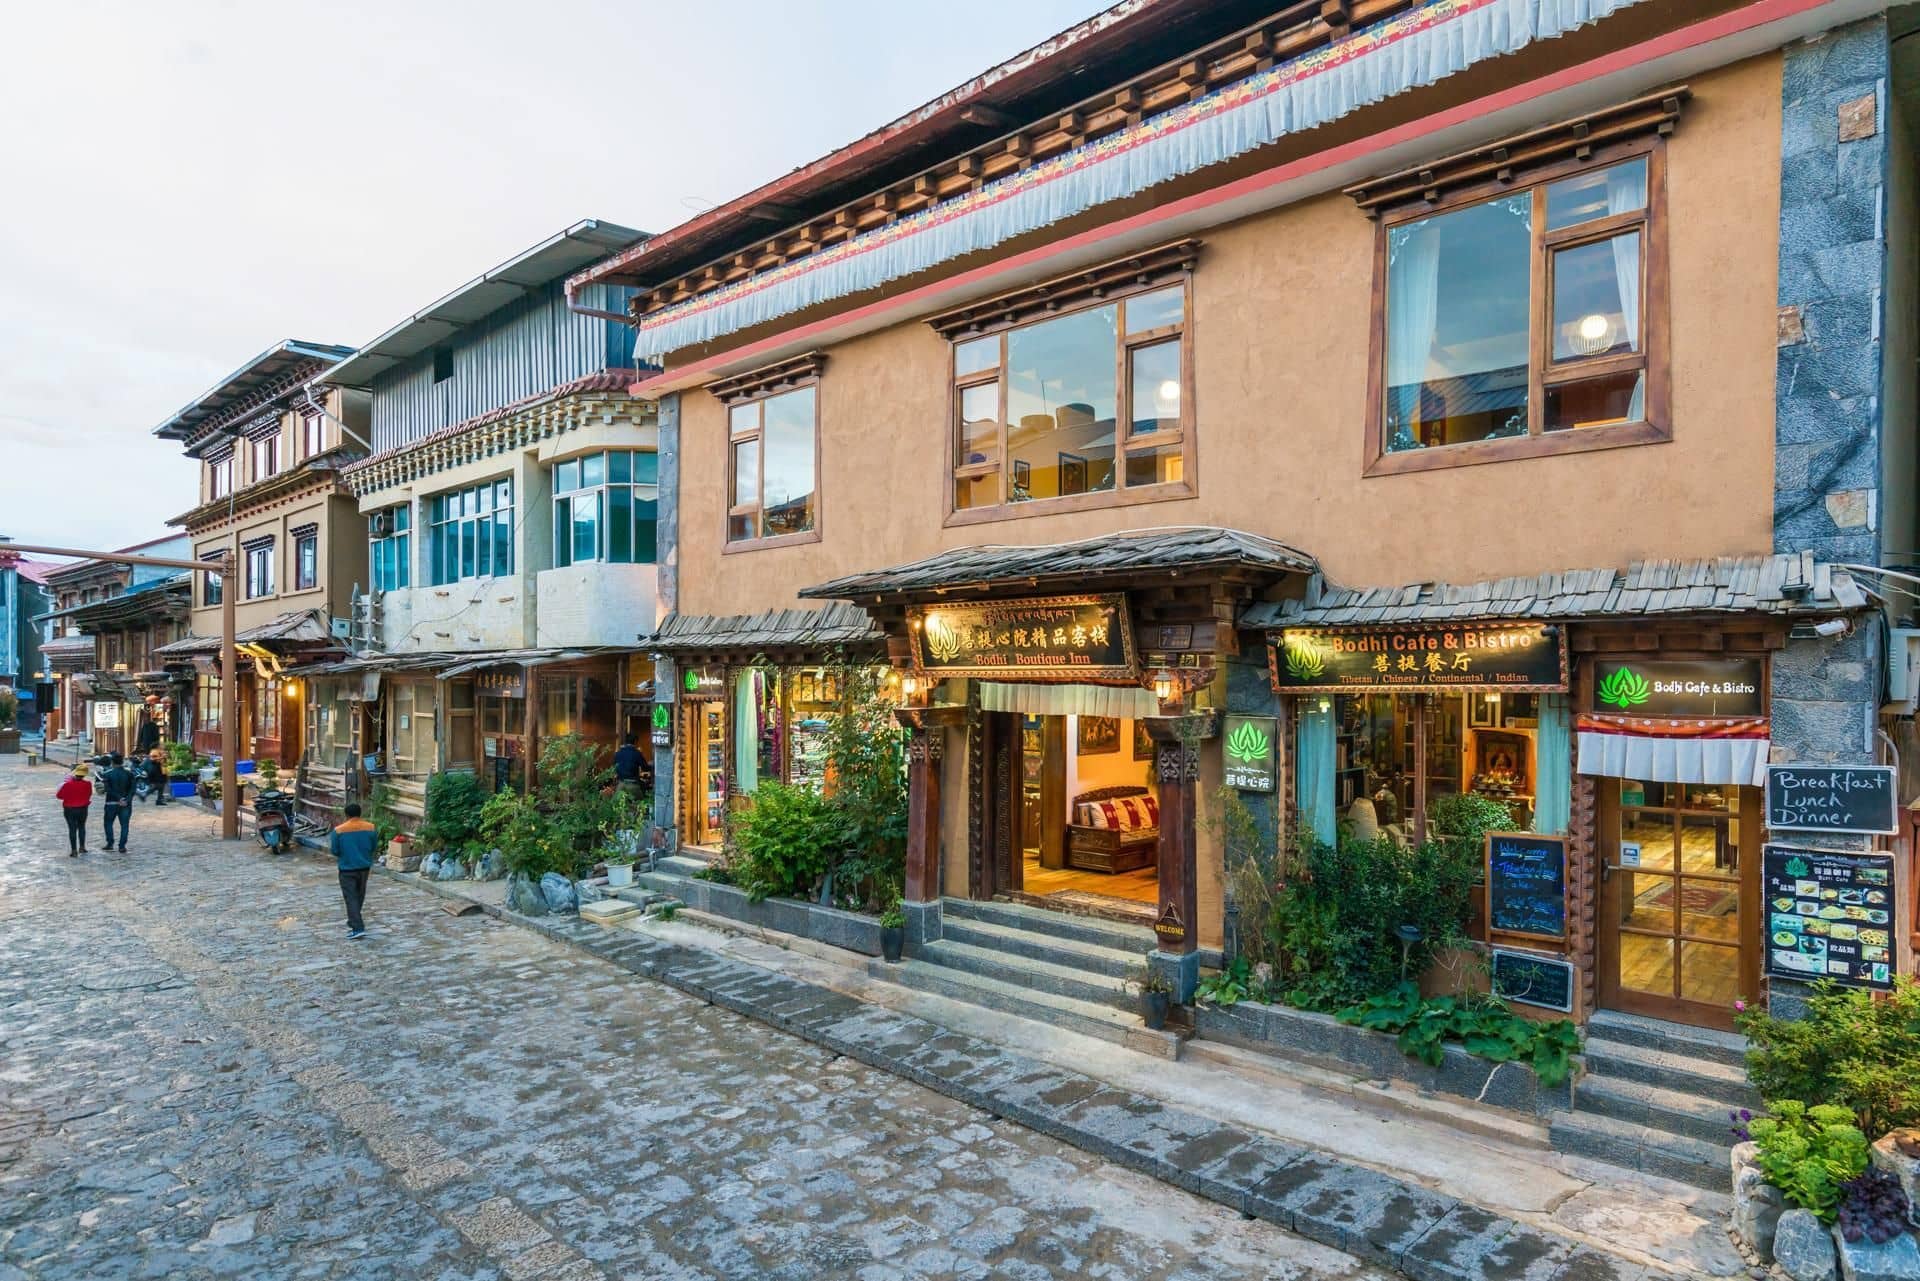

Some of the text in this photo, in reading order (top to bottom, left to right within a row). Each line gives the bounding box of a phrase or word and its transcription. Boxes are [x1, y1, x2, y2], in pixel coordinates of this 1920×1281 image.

[961, 626, 1111, 650] 菩提心院精品客栈
[1333, 631, 1531, 653] Bodhi Cafe & Bistro
[976, 652, 1091, 666] Bodhi Boutique Inn
[1371, 652, 1472, 673] 菩提餐厅
[1382, 673, 1418, 684] Chinese
[1429, 673, 1484, 683] Continental
[1495, 672, 1529, 683] Indian
[1712, 683, 1722, 694] &
[1723, 682, 1755, 694] Bistro
[1226, 774, 1270, 789] 菩提心院
[1784, 790, 1845, 808] Lunch
[1772, 807, 1853, 825] Dinner
[1154, 924, 1184, 936] WELCOME
